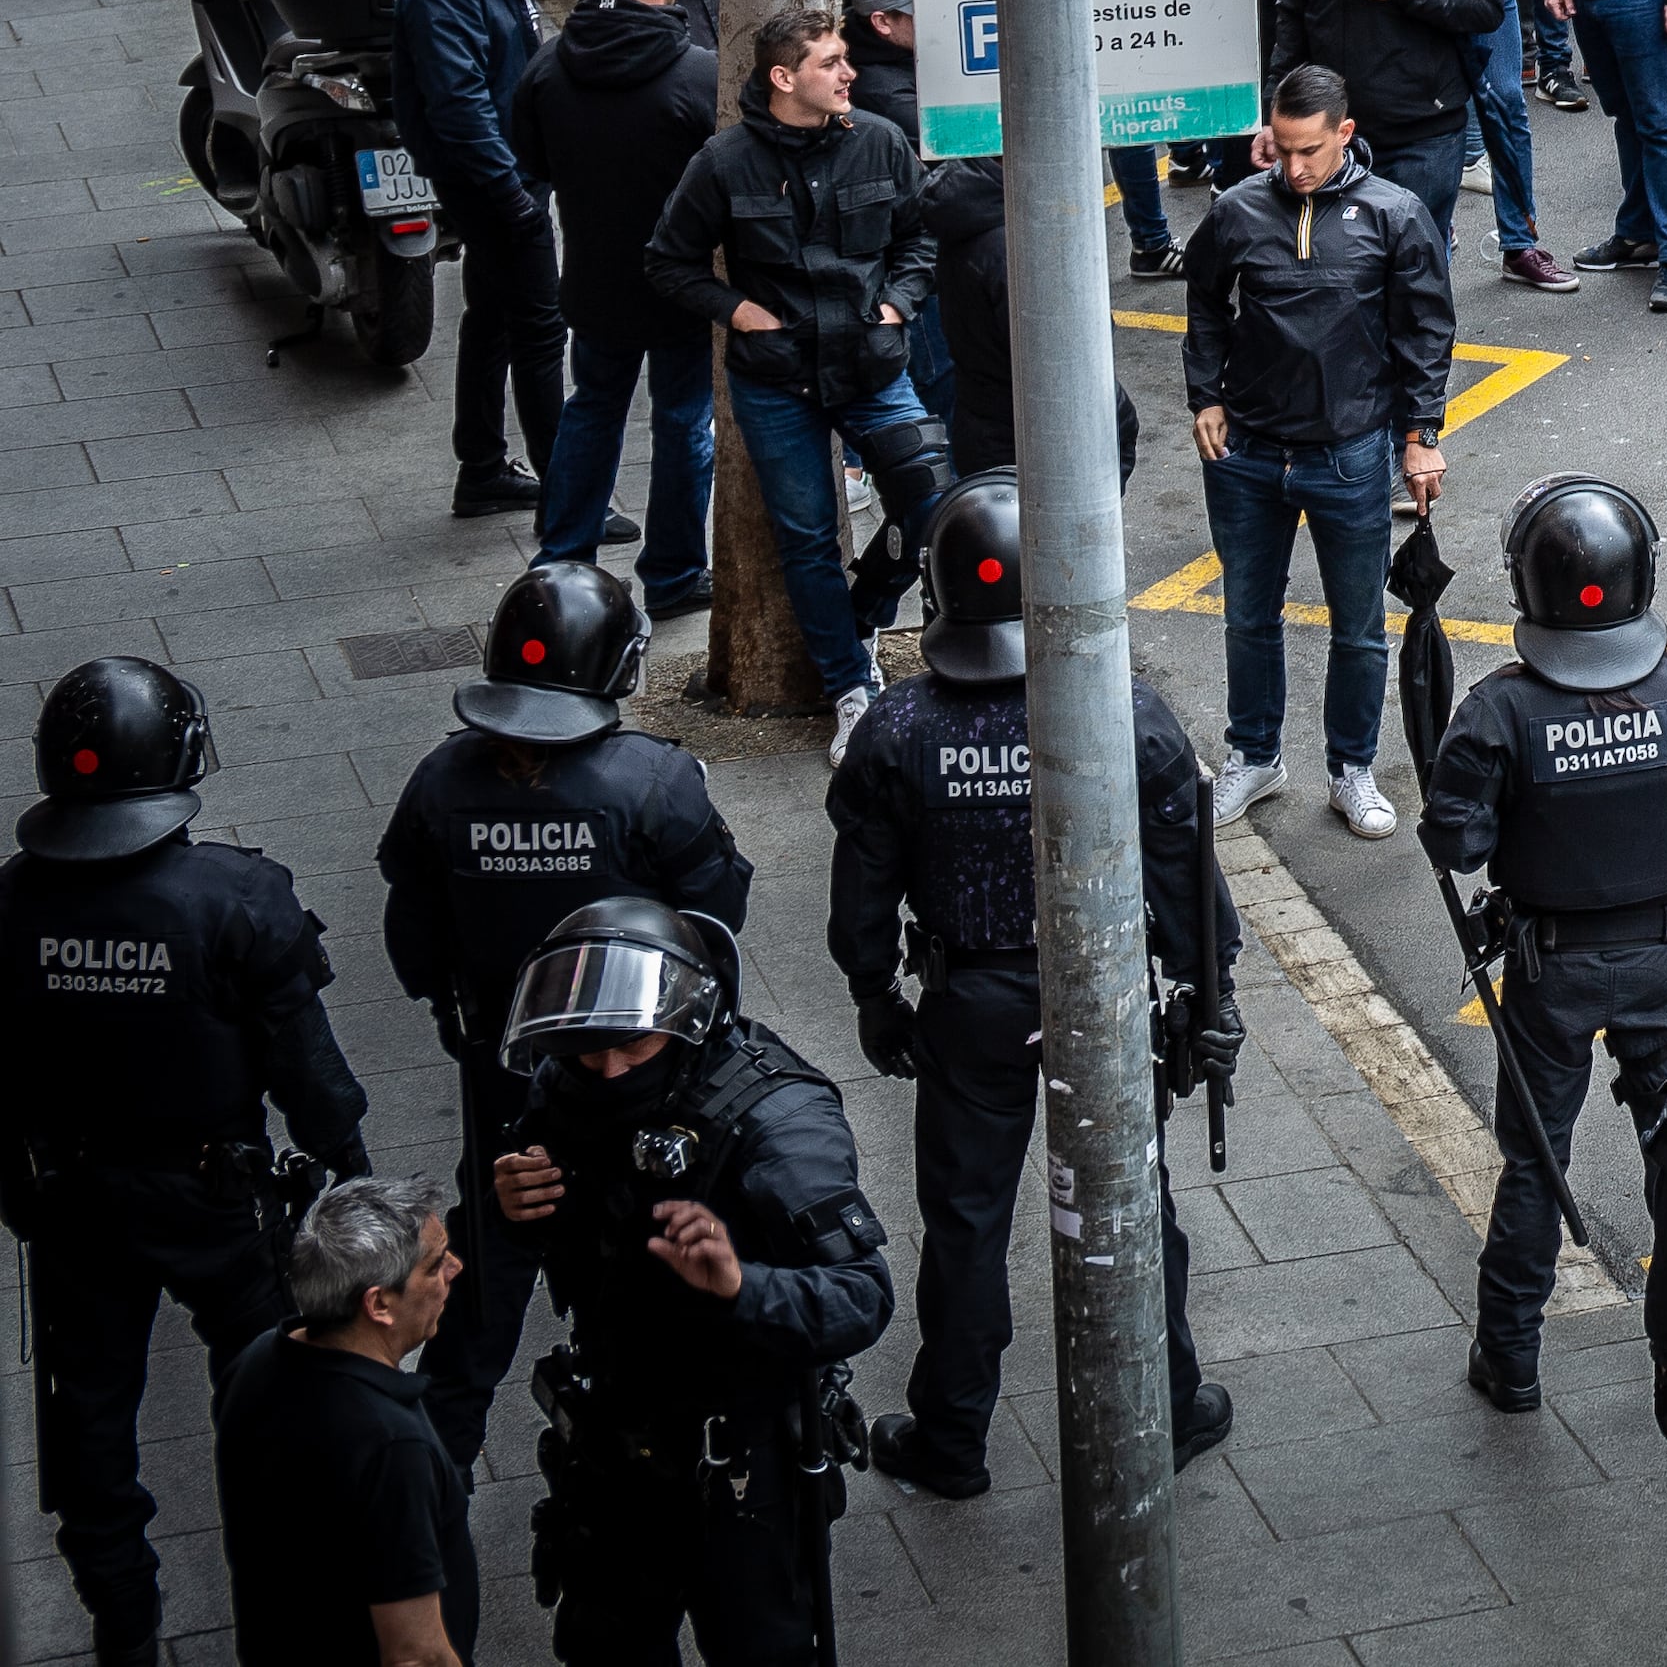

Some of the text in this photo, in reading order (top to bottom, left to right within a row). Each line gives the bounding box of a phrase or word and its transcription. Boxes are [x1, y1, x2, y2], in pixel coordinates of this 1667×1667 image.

[1092, 0, 1192, 23] estius de
[1110, 37, 1124, 51] a
[1130, 32, 1157, 51] 24
[1163, 30, 1184, 48] h.
[1109, 94, 1187, 113] minuts
[1111, 117, 1179, 136] horari
[381, 153, 411, 177] 02
[365, 173, 375, 183] E
[386, 177, 428, 201] JJJ
[1545, 709, 1663, 752] POLICIA
[939, 744, 1031, 775] POLIC
[1555, 743, 1659, 774] D311A7058
[947, 778, 1032, 798] D113A67
[470, 822, 597, 851] POLICIA
[479, 854, 592, 873] D303A3685
[39, 937, 172, 972] POLICIA
[47, 973, 166, 994] D303A5472
